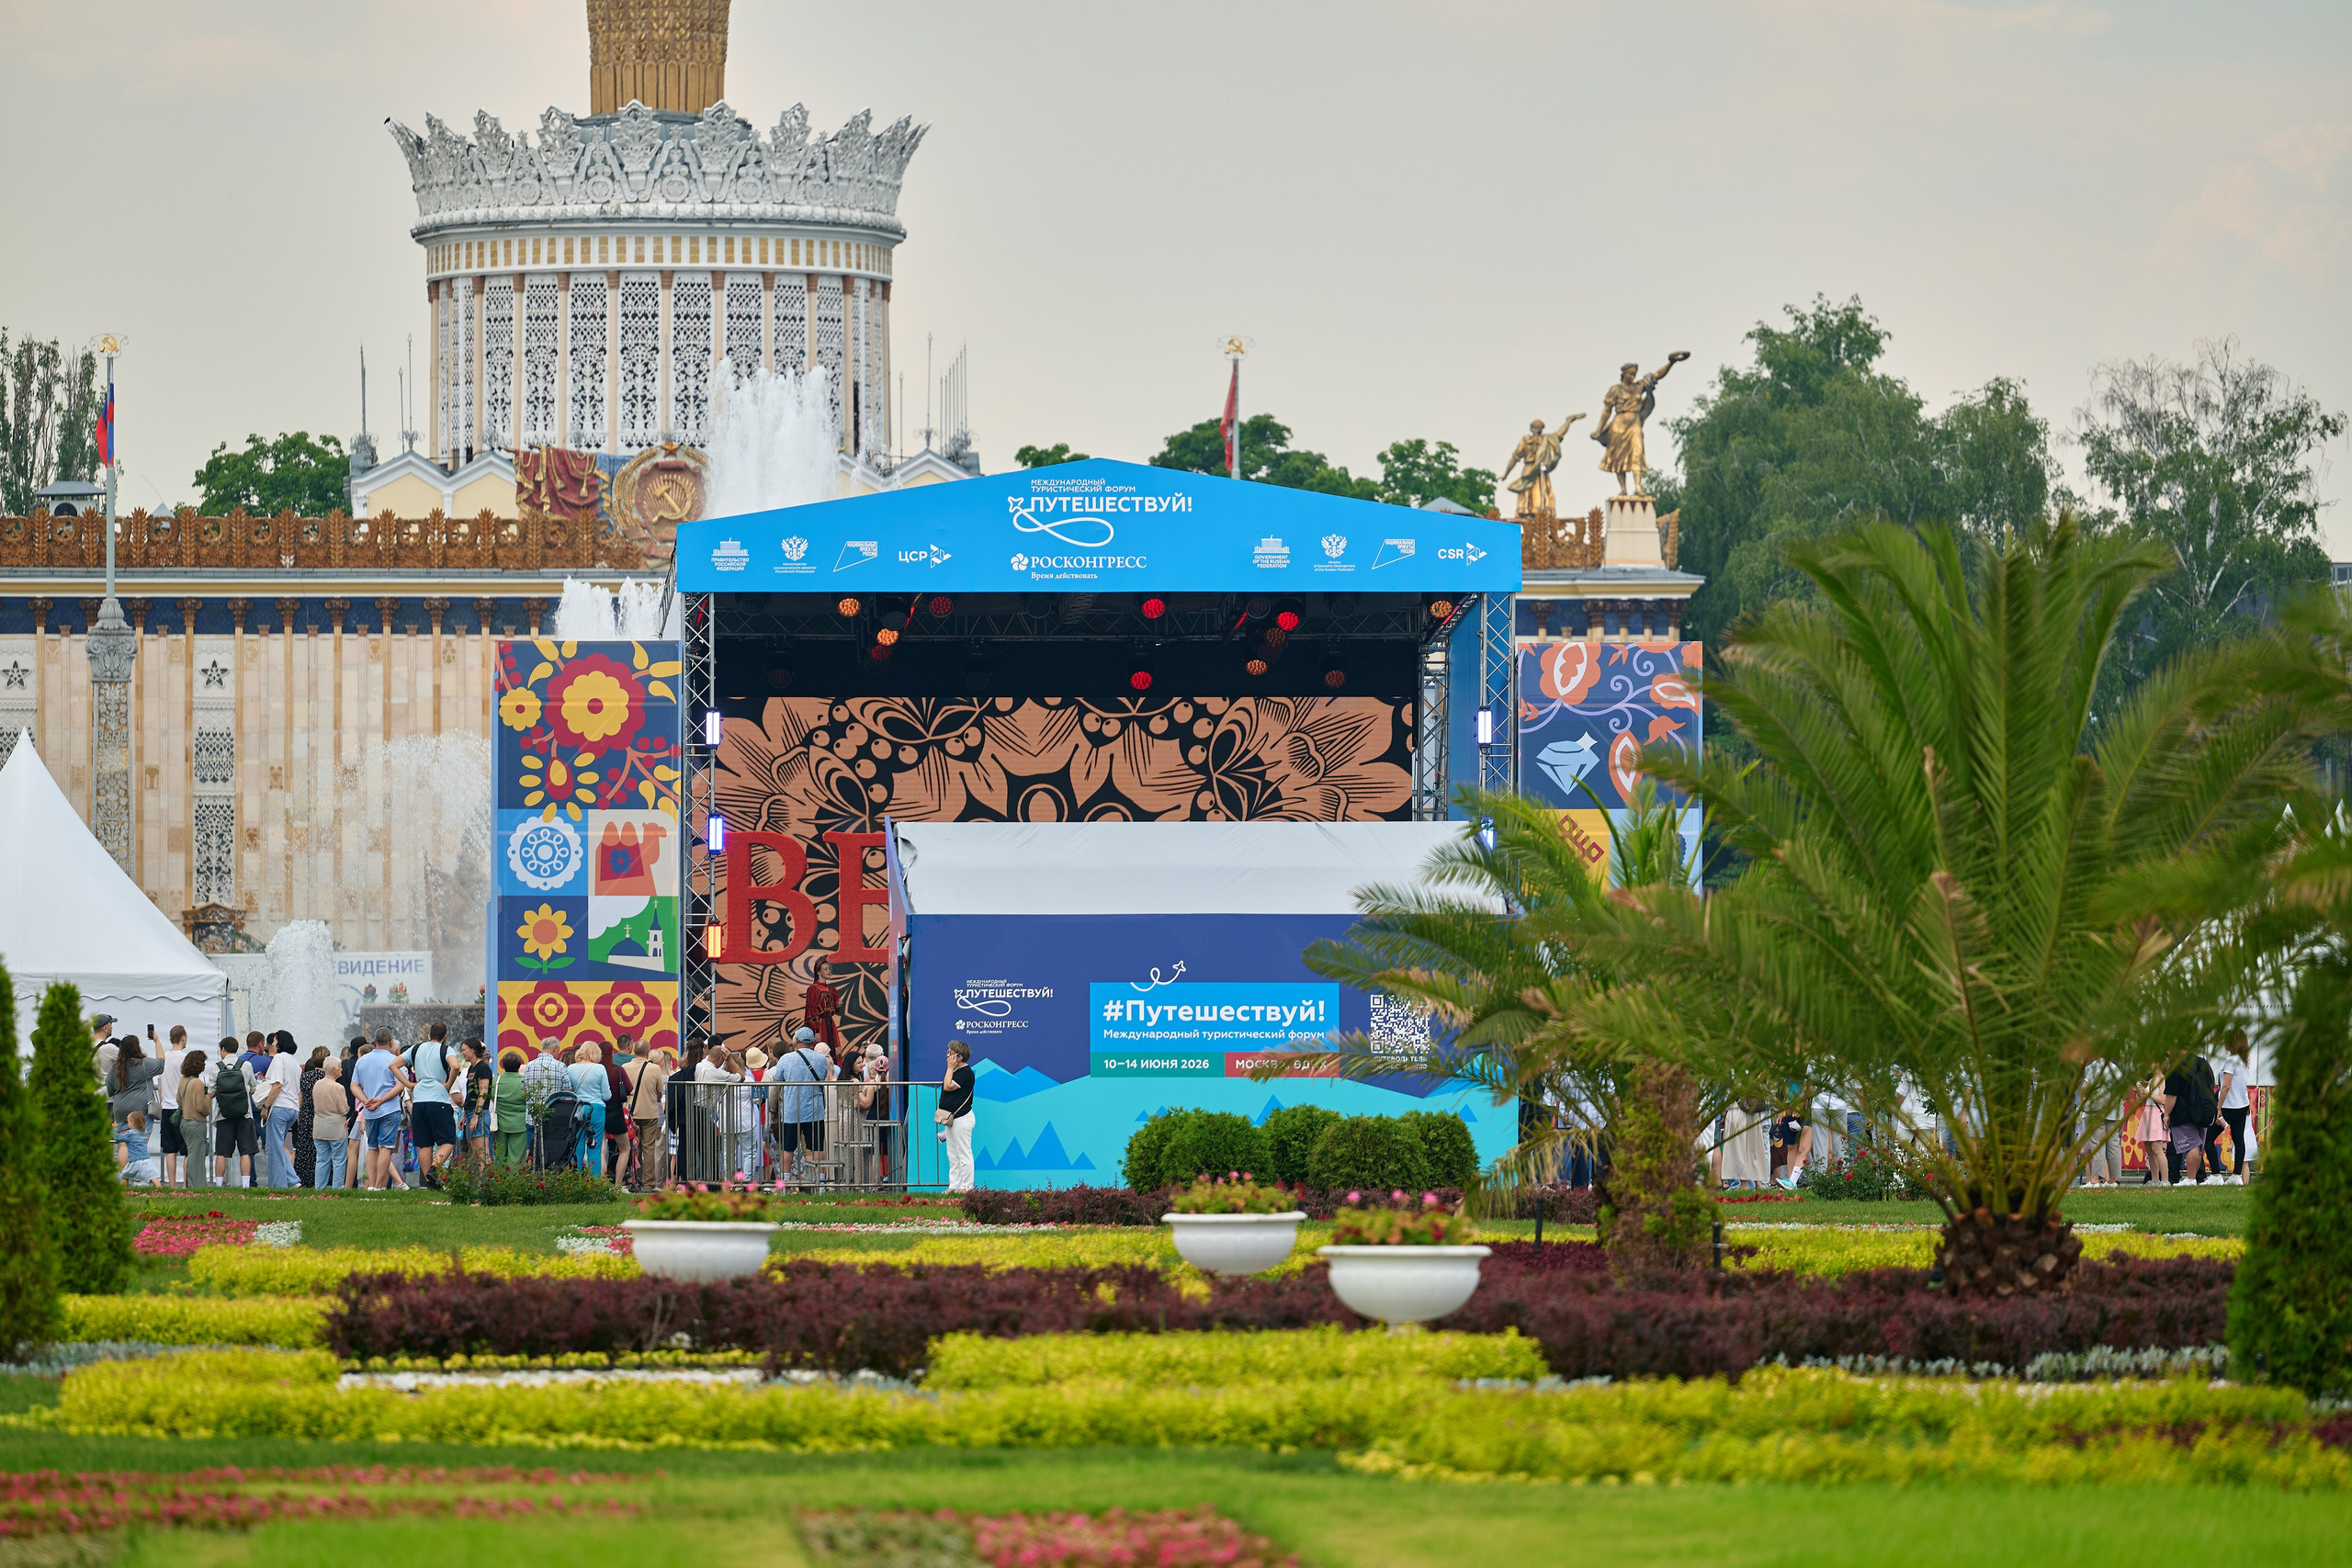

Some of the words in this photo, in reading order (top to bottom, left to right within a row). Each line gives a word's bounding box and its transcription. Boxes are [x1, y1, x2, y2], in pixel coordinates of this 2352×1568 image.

[1031, 478, 1105, 486] МЕЖДУНАРОДНЫЙ
[1030, 492, 1193, 513] ПУТЕШЕСТВУЙ!
[899, 550, 928, 563] ЦСР
[1438, 548, 1464, 559] CSR
[1031, 556, 1147, 569] РОСКОНГРЕСС
[1031, 571, 1054, 581] Время
[1055, 571, 1098, 580] действовать
[332, 958, 424, 976] ВИДЕНИЕ
[966, 987, 1054, 998] ПУТЕШЕСТВУЙ!
[1102, 999, 1325, 1027] #Путешествуй!
[1103, 1028, 1199, 1040] Международный
[1202, 1029, 1285, 1040] туристический
[1287, 1029, 1325, 1041] форум
[1140, 1059, 1178, 1069] ИЮНЯ
[1181, 1059, 1210, 1069] 2026
[1294, 1059, 1329, 1070] ВДХ
